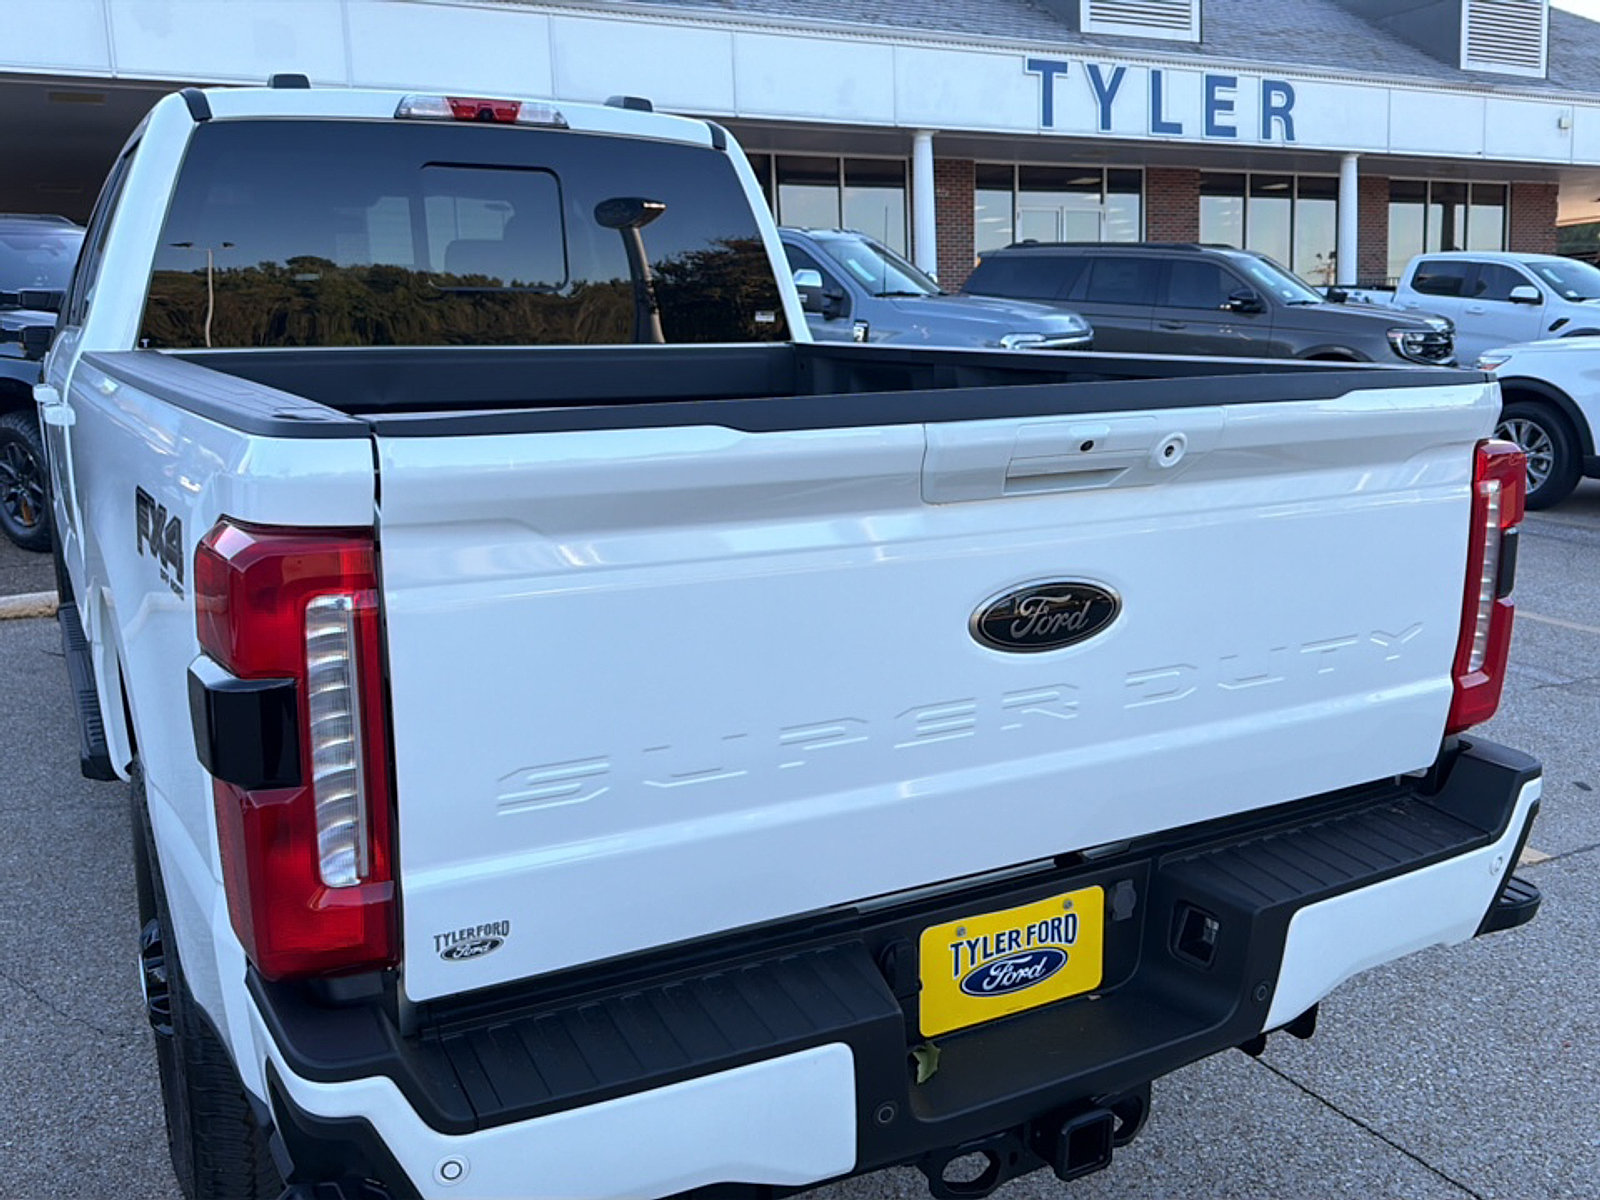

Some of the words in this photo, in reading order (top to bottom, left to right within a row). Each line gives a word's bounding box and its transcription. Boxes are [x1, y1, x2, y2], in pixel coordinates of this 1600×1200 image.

[1027, 58, 1296, 141] TYLER
[135, 485, 184, 586] FX4
[1010, 594, 1092, 639] Ford
[497, 683, 1079, 816] SUPER
[1123, 621, 1423, 709] DUTY
[433, 927, 476, 953] TYLER
[476, 920, 510, 937] FORD
[950, 929, 1022, 978] TYLER
[1026, 913, 1077, 946] FORD
[982, 955, 1048, 991] Ford
